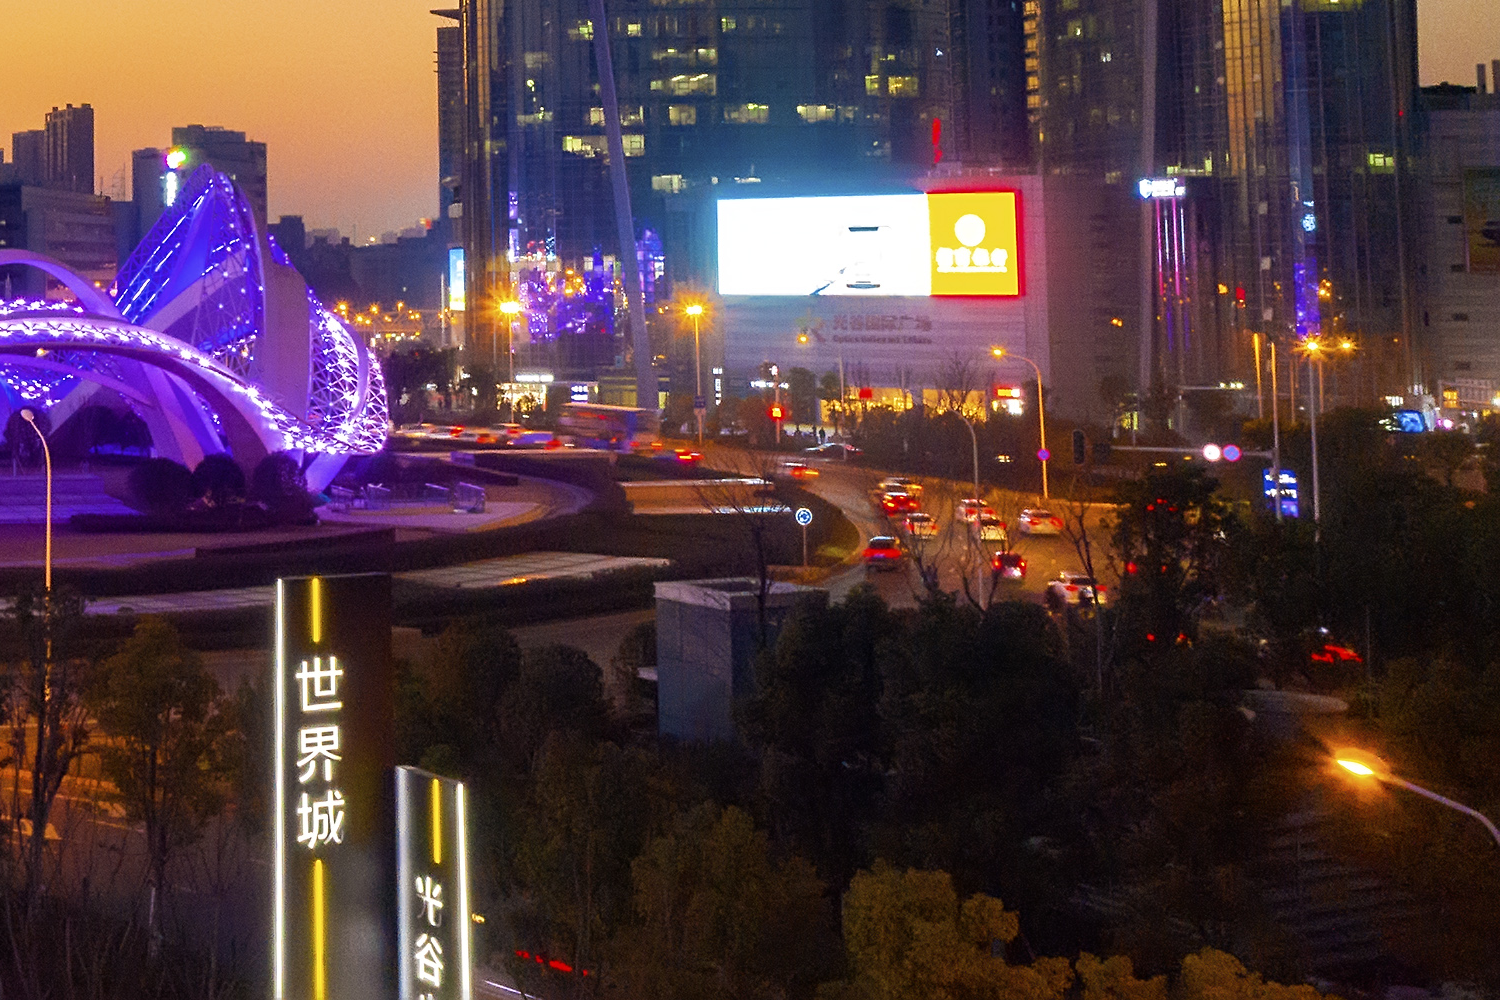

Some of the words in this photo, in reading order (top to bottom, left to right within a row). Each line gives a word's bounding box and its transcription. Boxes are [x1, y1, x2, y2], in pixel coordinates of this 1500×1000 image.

[296, 656, 345, 849] 世界城
[415, 876, 444, 1000] 光谷
